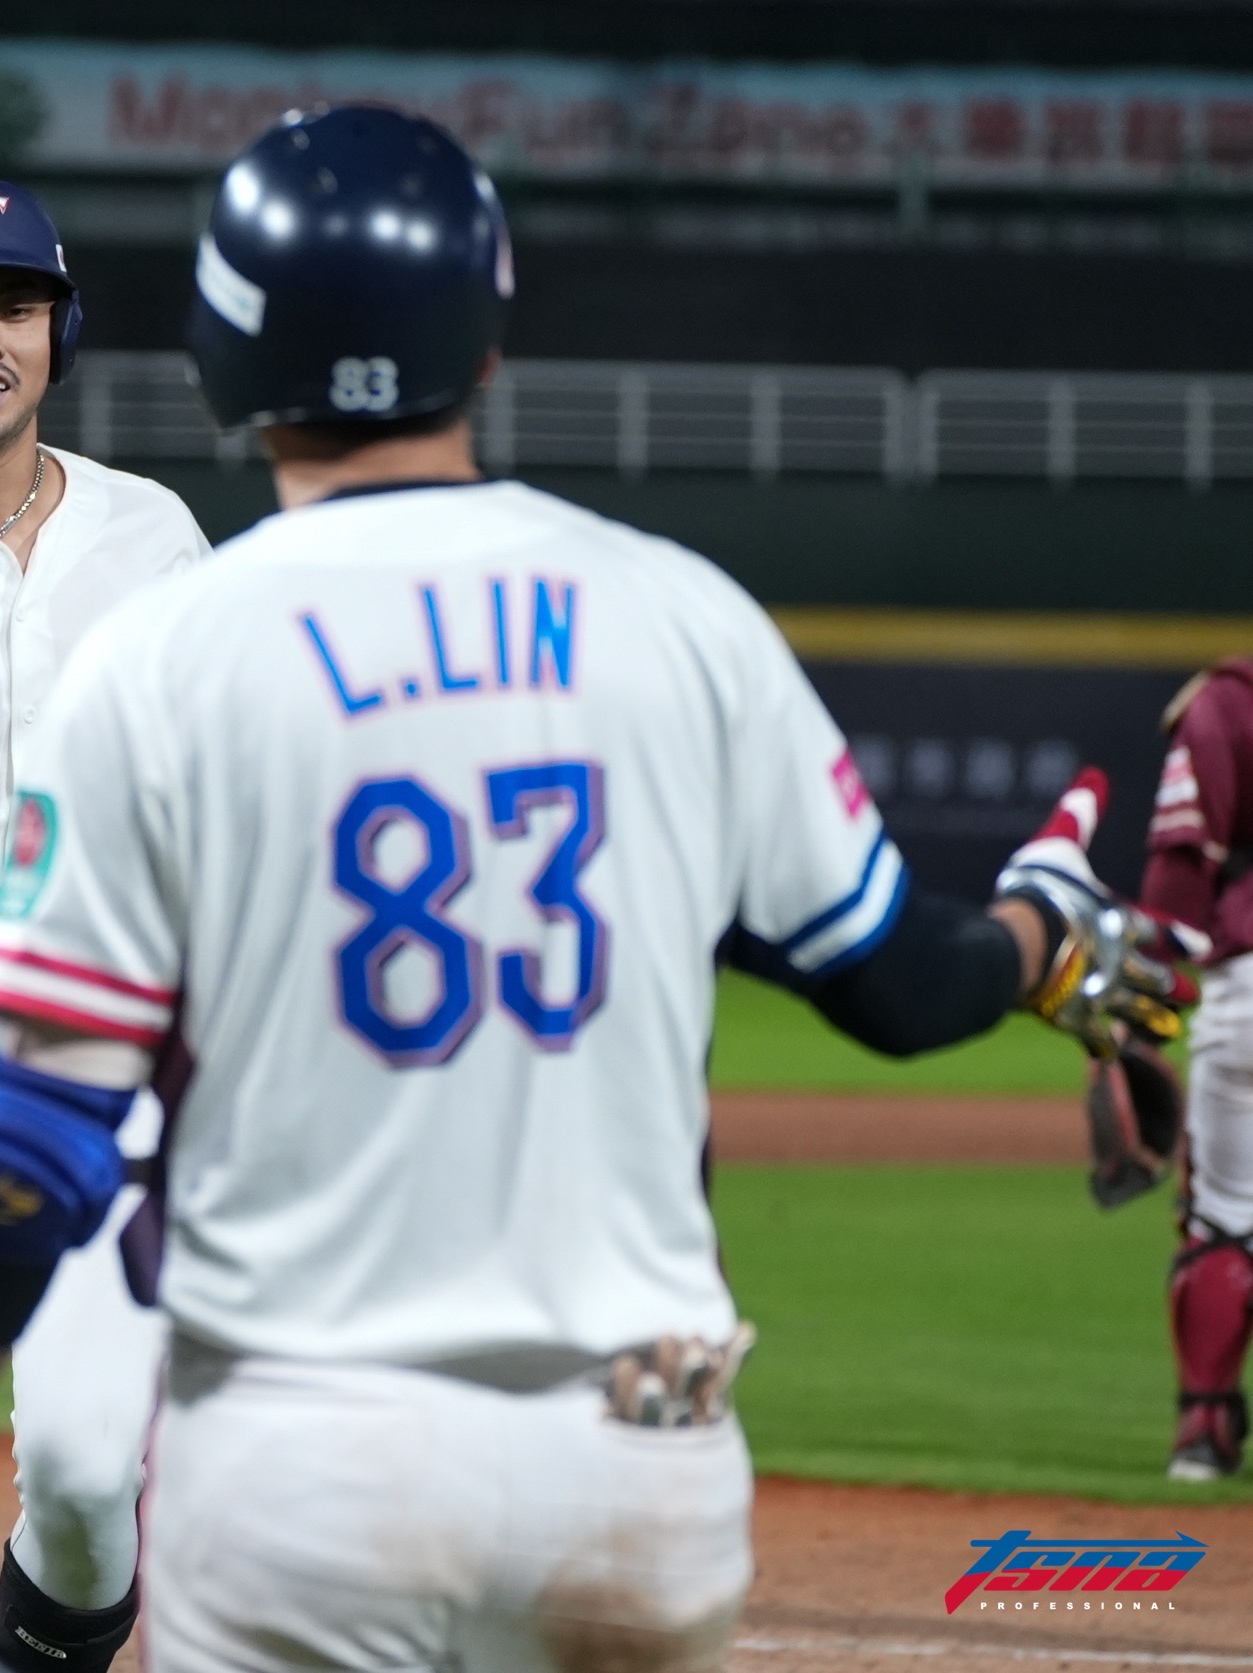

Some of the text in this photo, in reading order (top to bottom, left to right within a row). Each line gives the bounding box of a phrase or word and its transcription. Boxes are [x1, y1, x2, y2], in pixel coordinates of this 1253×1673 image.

[330, 356, 399, 412] 83
[300, 574, 576, 720] L.LIN
[330, 758, 606, 1067] 83
